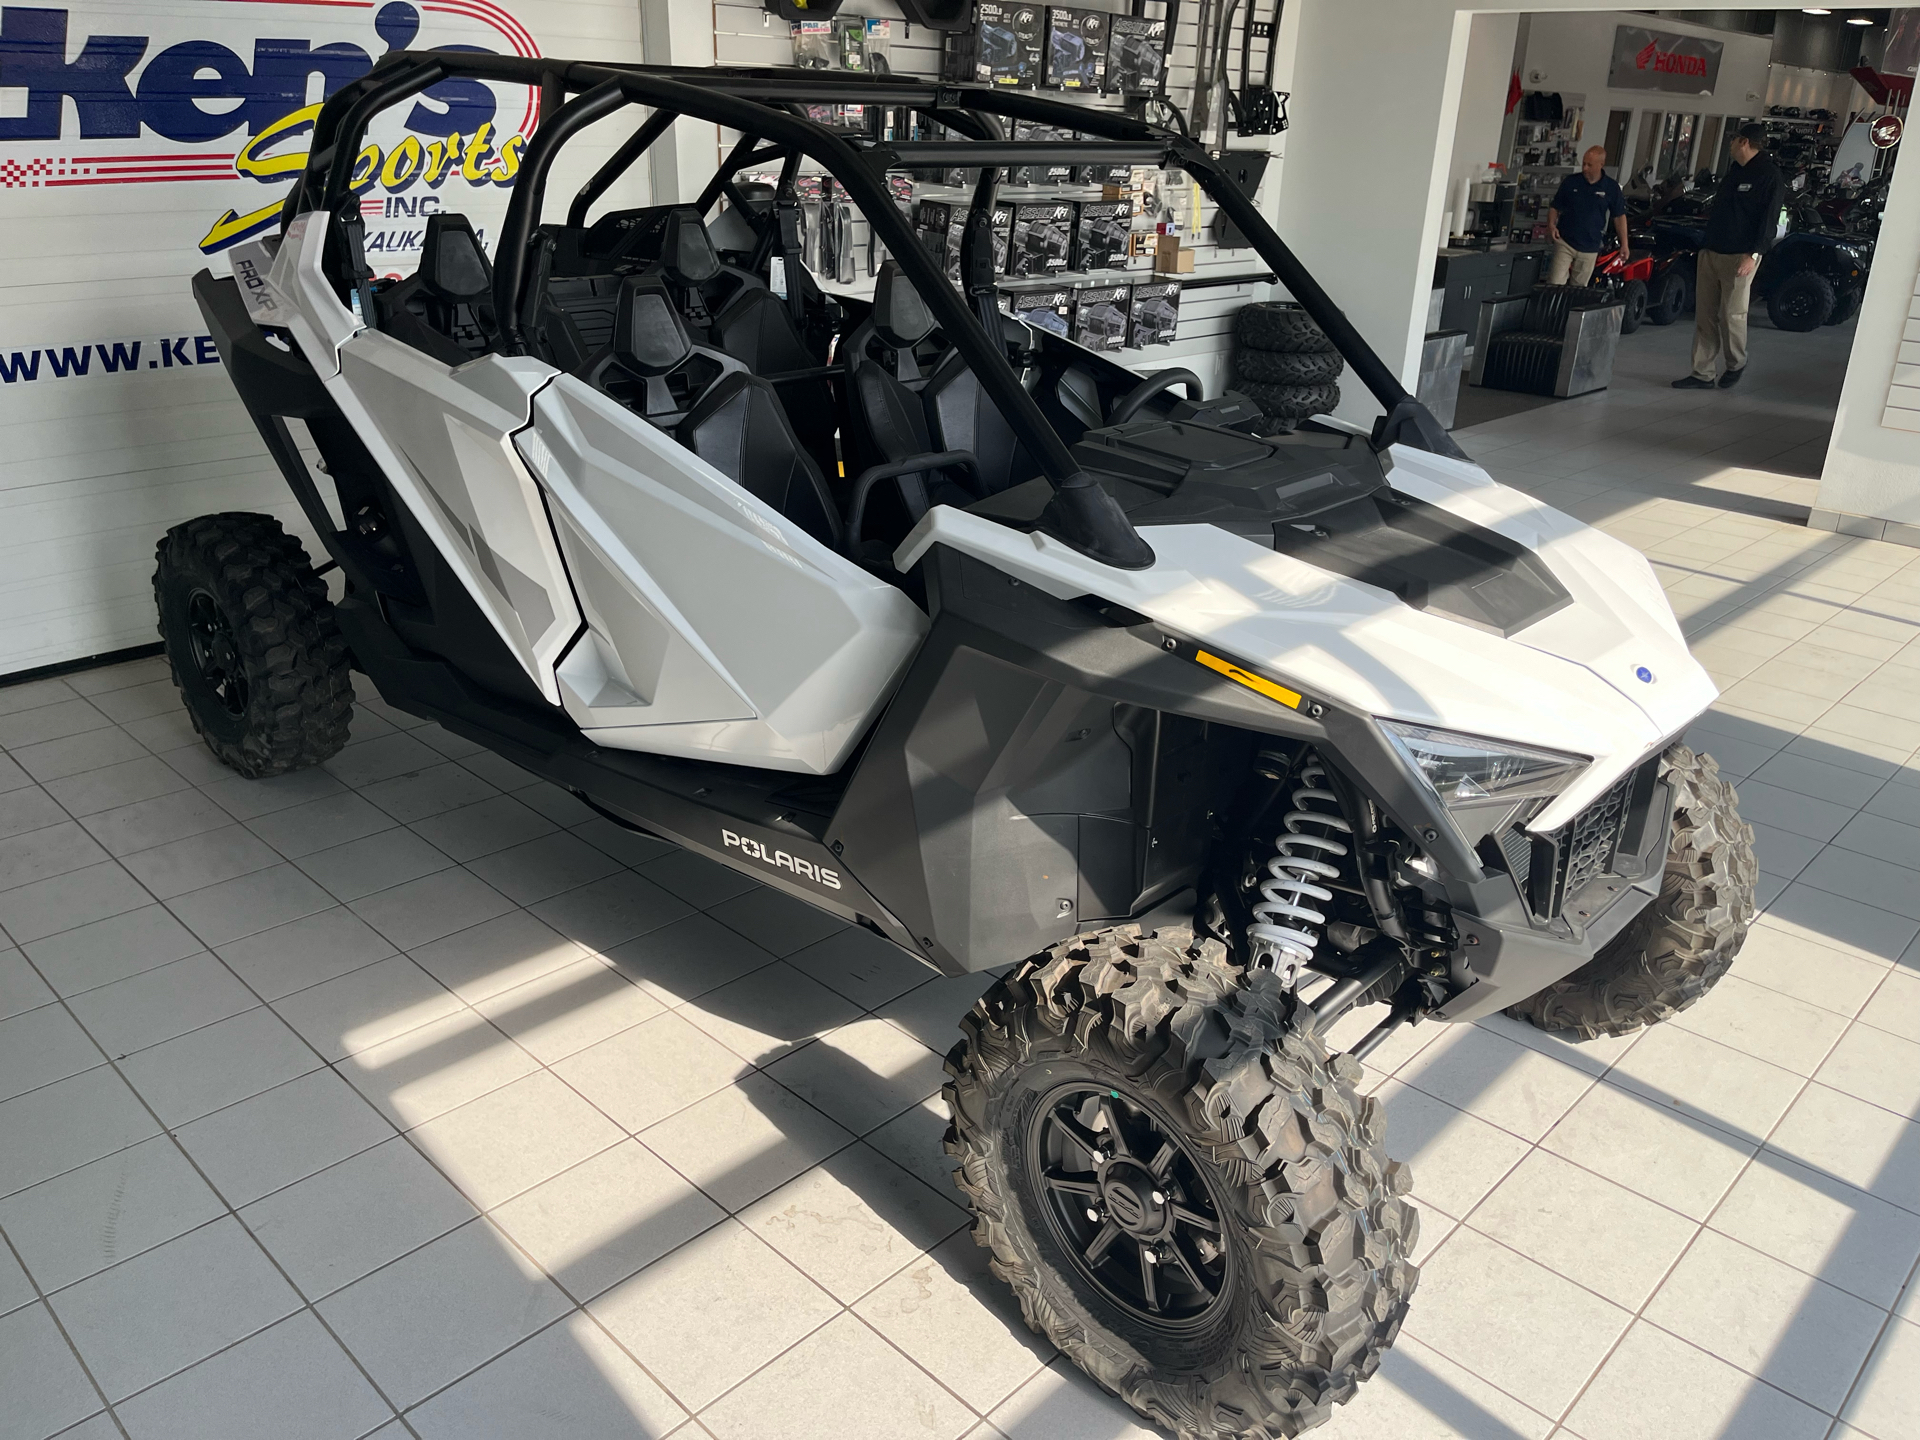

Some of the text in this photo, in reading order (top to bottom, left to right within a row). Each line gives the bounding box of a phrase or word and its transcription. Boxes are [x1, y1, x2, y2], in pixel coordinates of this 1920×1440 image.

[1111, 17, 1150, 34] ASSAULT
[1653, 51, 1707, 77] HONDA
[1018, 205, 1055, 219] ASSAULT
[1080, 204, 1117, 217] ASSAULT
[1079, 290, 1115, 303] ASSAULT
[1134, 285, 1168, 298] ASSAULT
[1015, 294, 1054, 308] ASSAULT
[721, 828, 842, 890] POLARIS
